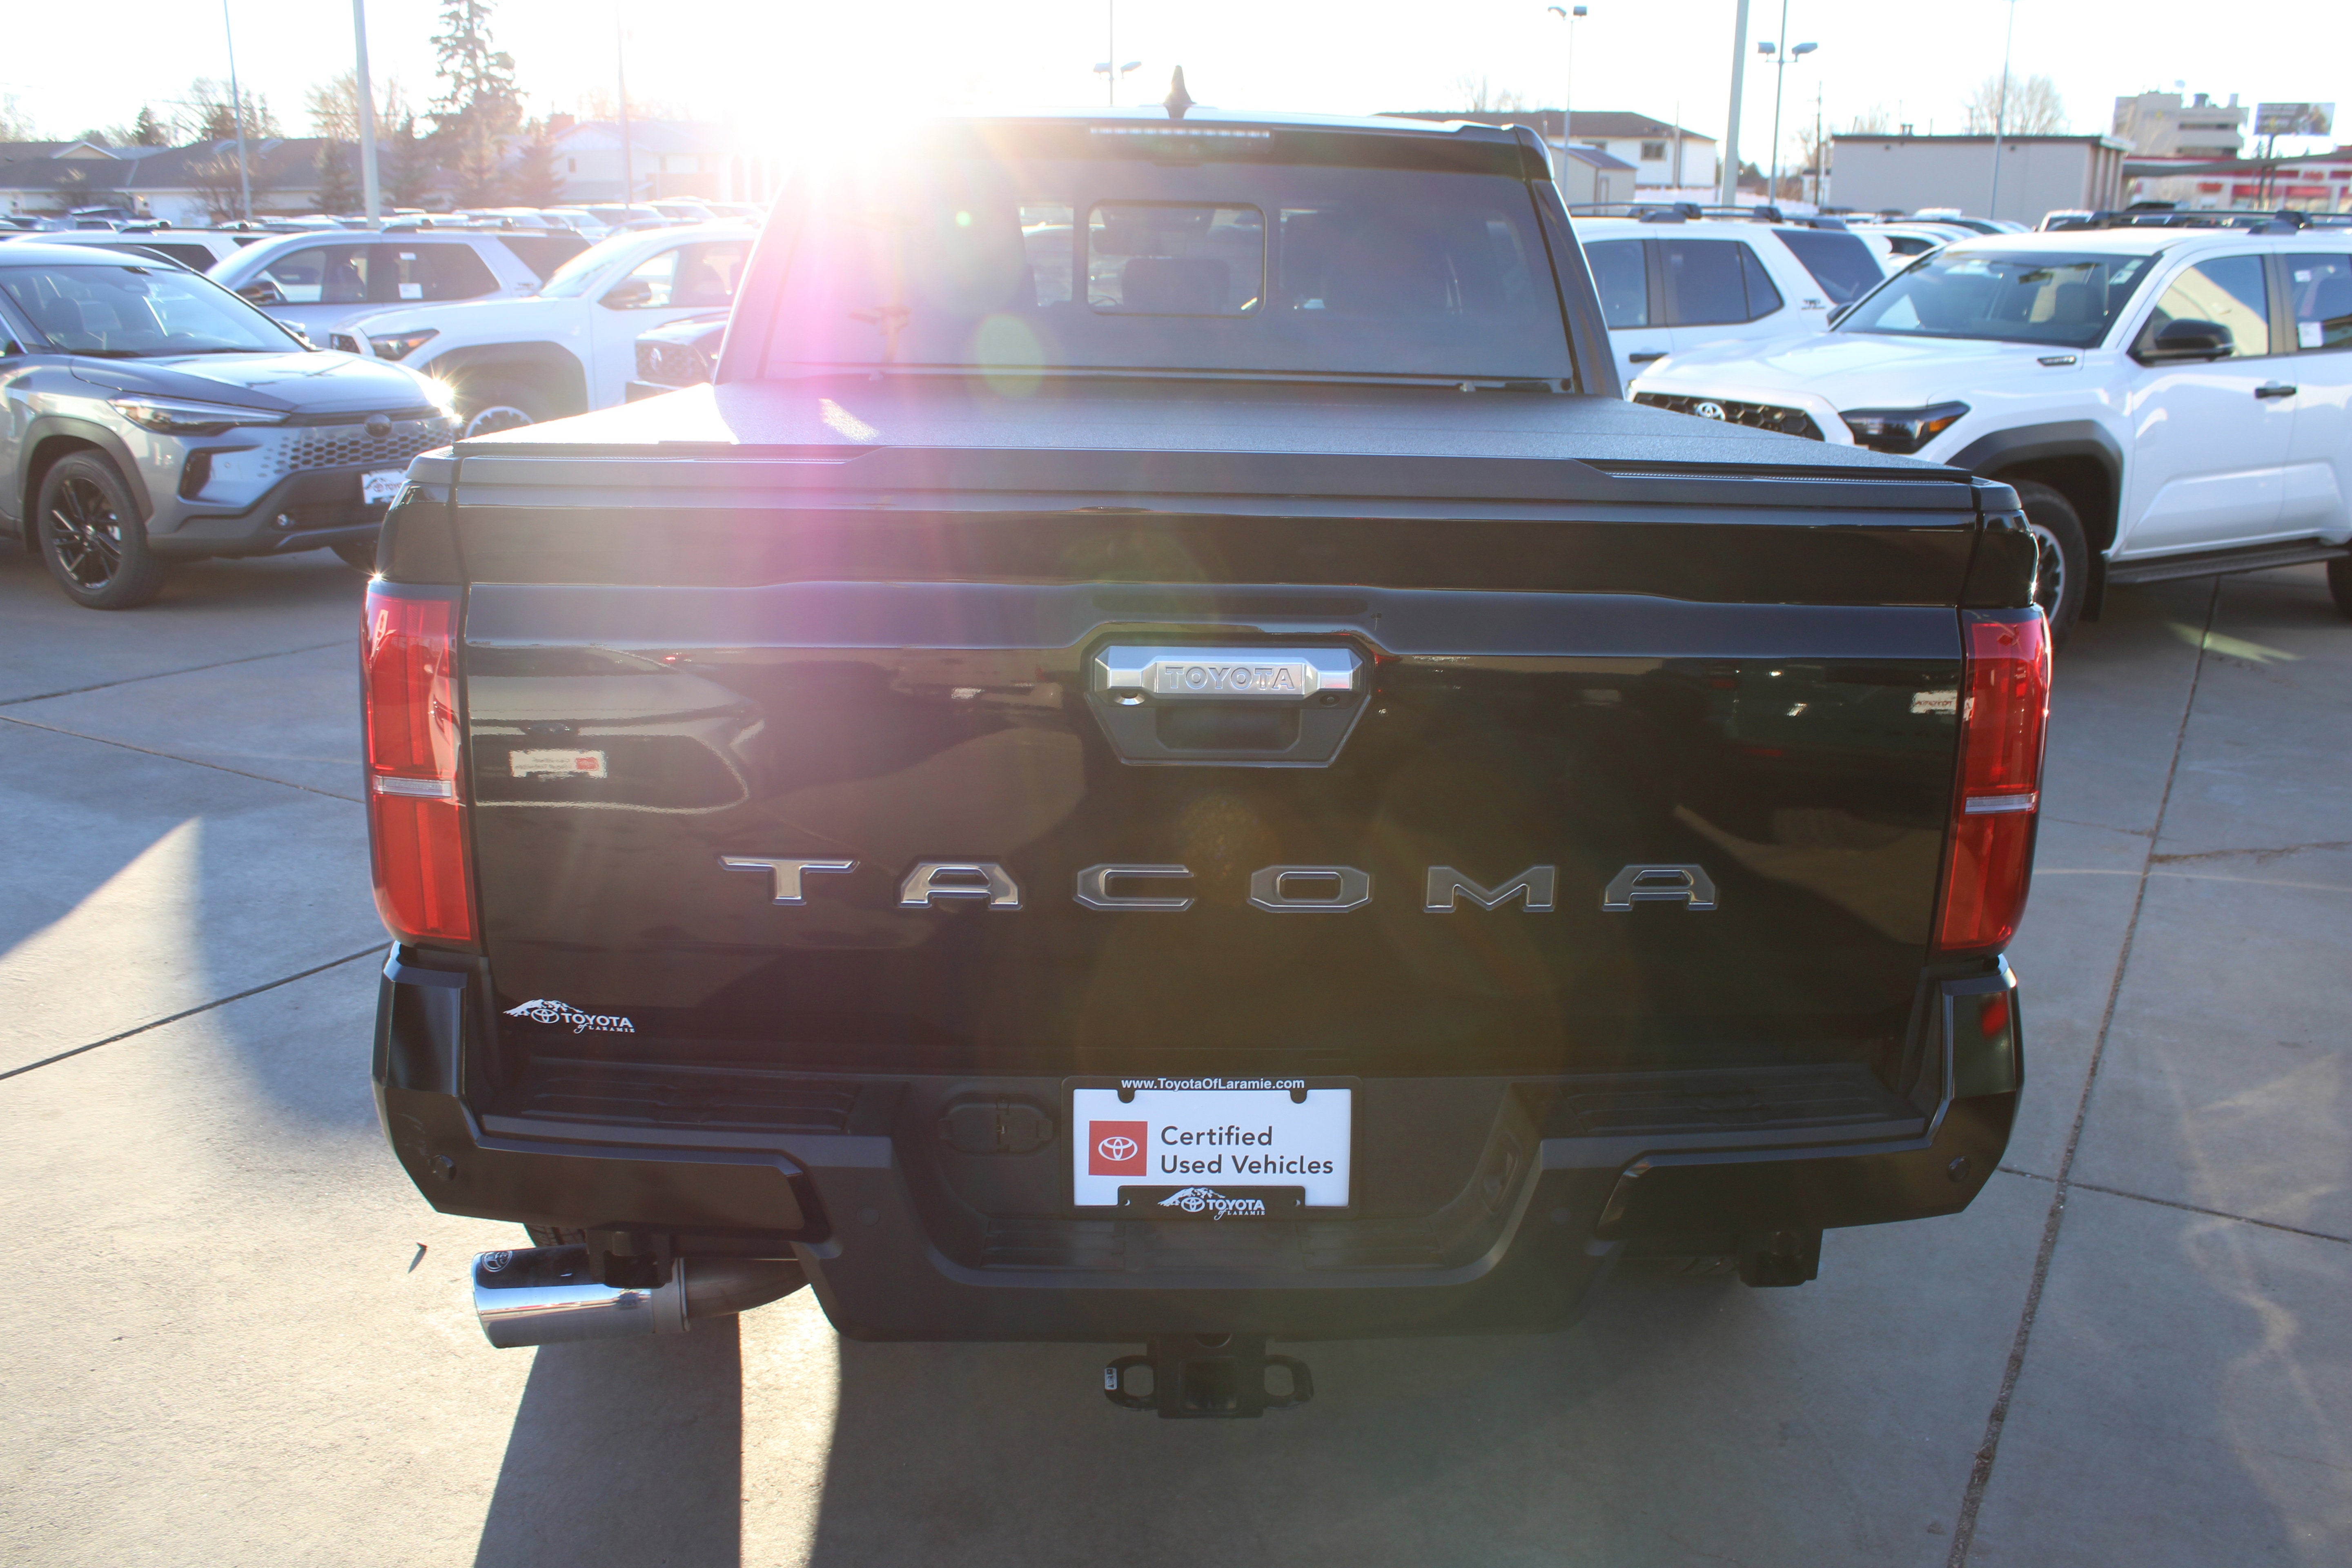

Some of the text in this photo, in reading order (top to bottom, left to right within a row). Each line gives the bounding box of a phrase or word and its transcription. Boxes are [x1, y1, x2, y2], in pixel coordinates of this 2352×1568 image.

[1165, 666, 1295, 690] TOYOTA
[719, 856, 1718, 912] TACOMA
[560, 1013, 633, 1028] TOYOTA
[573, 1022, 635, 1034] of LARAMIE
[1121, 1078, 1305, 1091] www.ToyotaOfLaramie.com
[1161, 1125, 1272, 1146] Certified
[1161, 1154, 1333, 1174] Used Vehicles
[1206, 1199, 1265, 1210] TOYOTA
[1214, 1208, 1229, 1221] of
